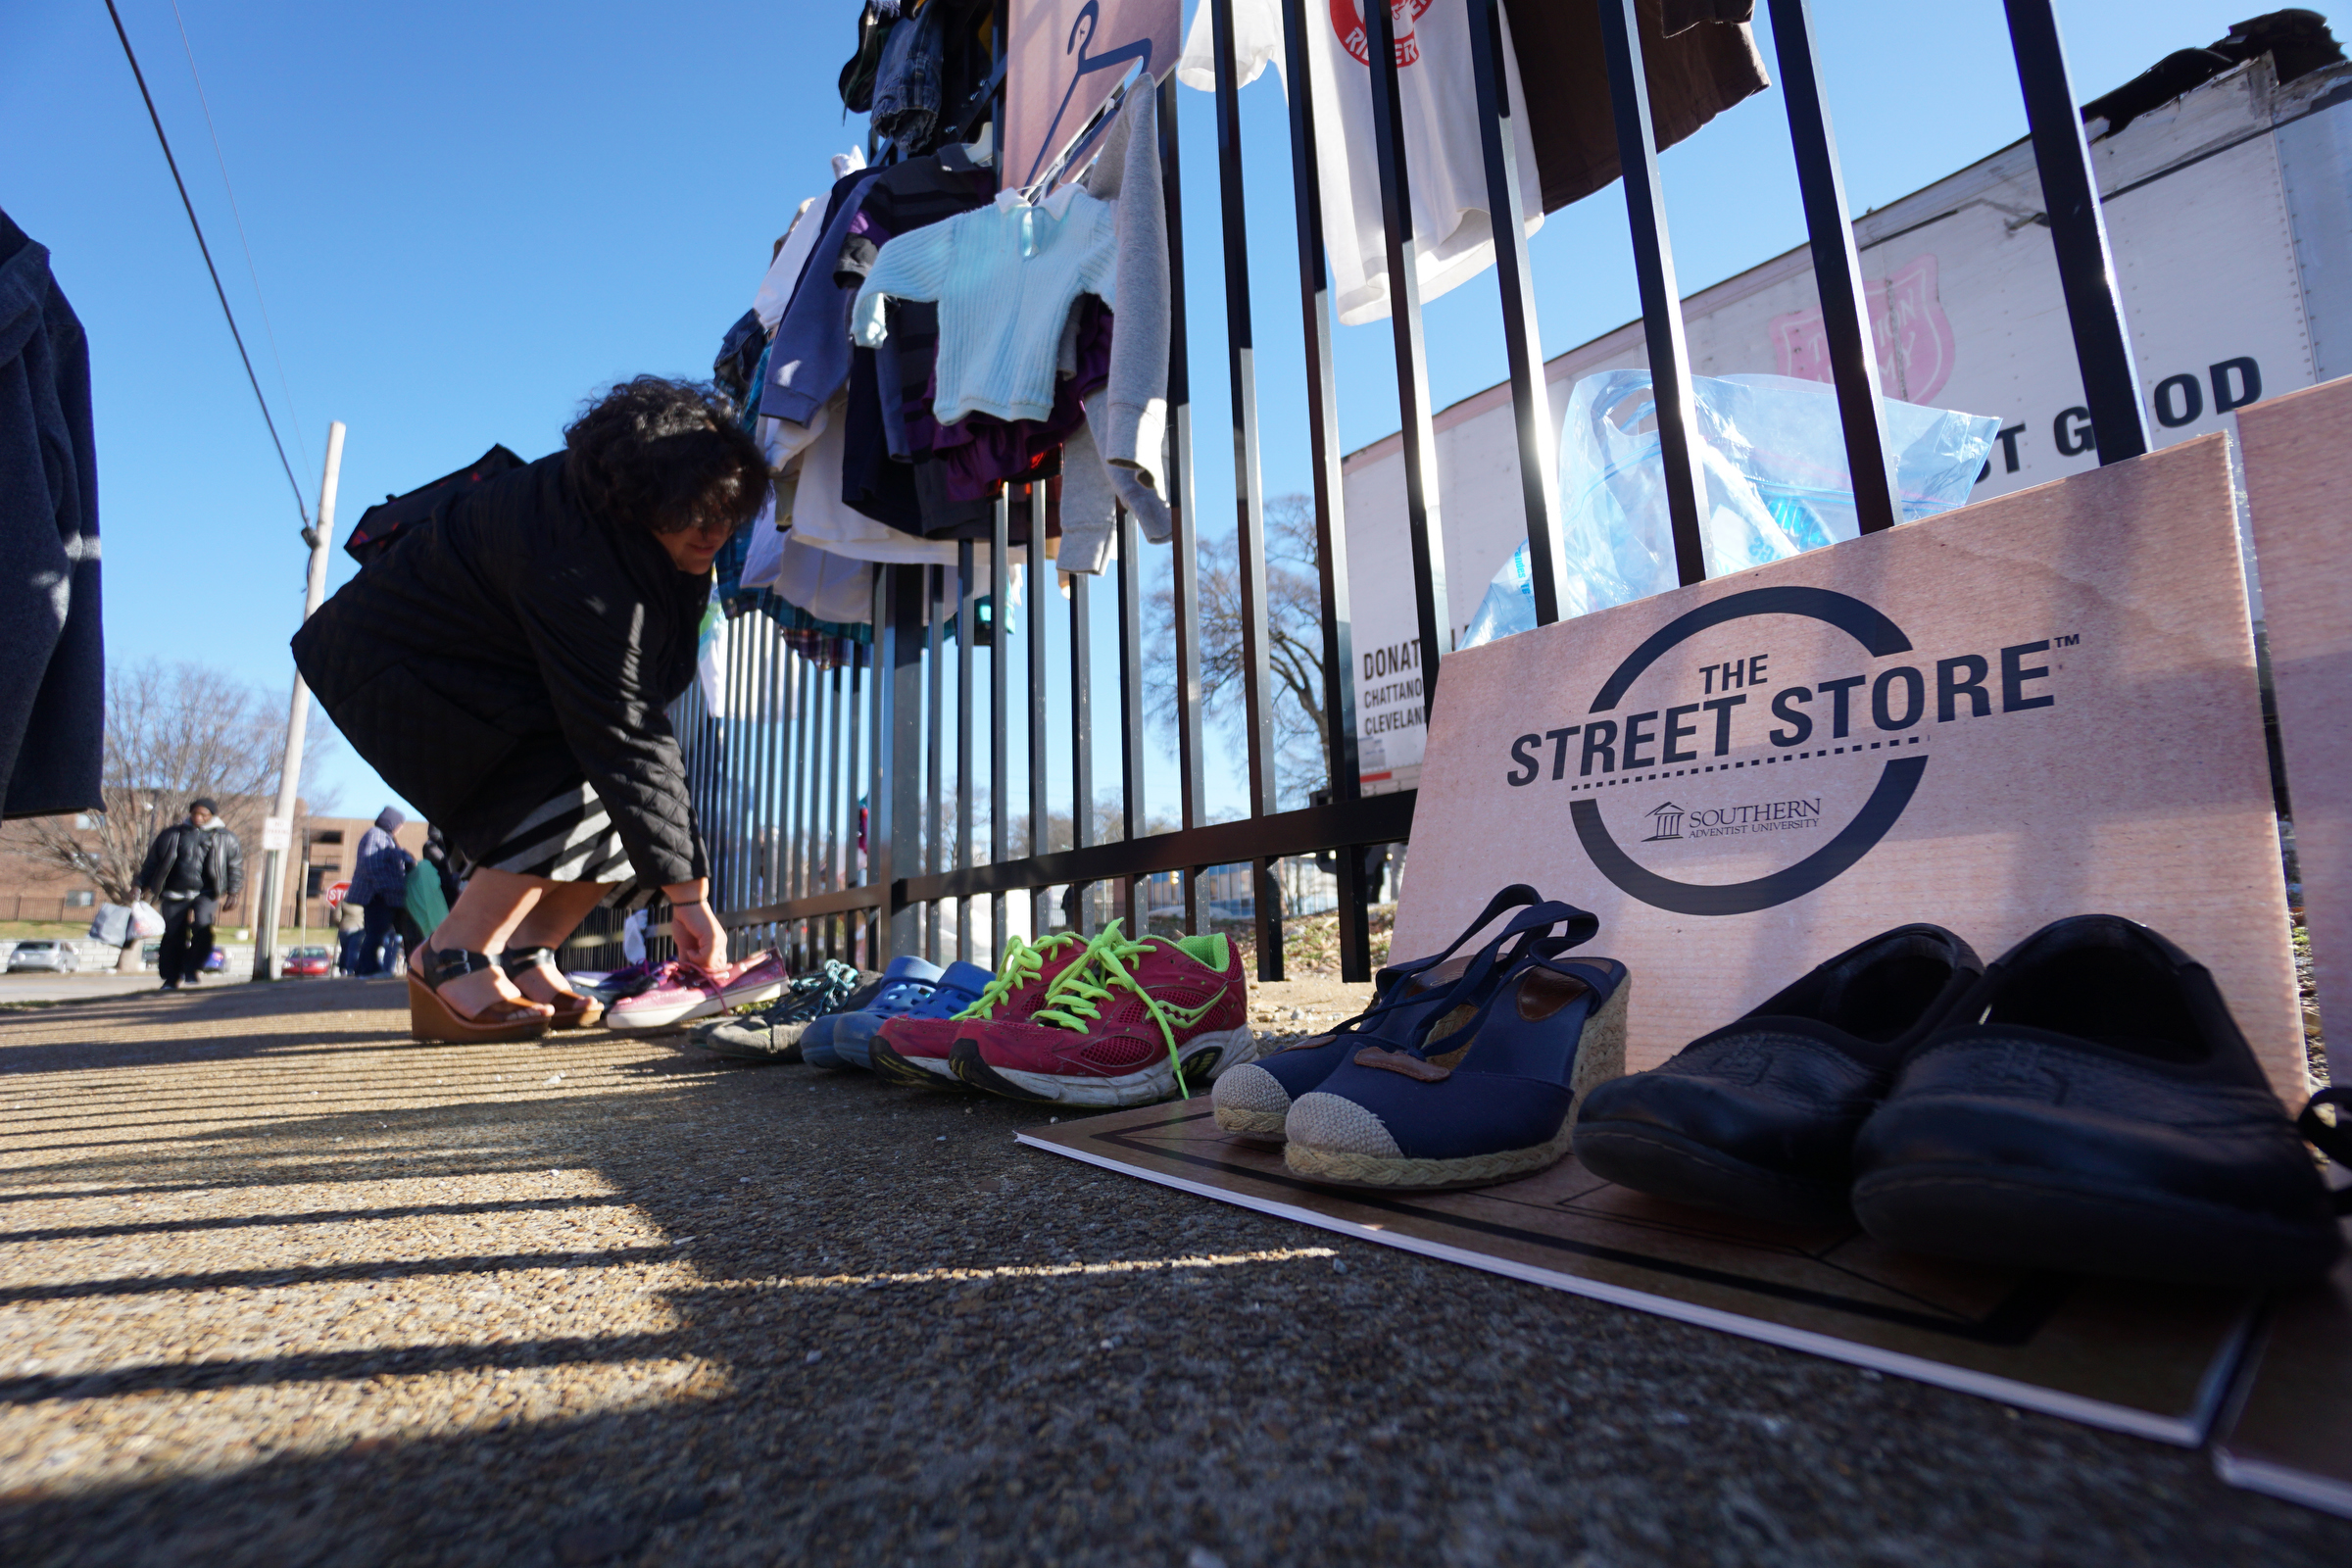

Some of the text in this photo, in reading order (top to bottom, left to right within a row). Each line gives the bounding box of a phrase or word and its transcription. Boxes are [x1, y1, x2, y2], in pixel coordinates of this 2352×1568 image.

[2053, 356, 2263, 458] GOD
[1363, 638, 1420, 681] DONAT
[1699, 654, 1768, 695] THE
[1364, 677, 1423, 710] CHATTANO
[1365, 706, 1427, 736] CLEVELAN
[1507, 694, 1746, 787] STREET
[1769, 639, 2055, 748] STORE
[1689, 798, 1821, 829] SOUTHERN
[1689, 818, 1820, 839] ADVENTIST UNIVERSITY
[328, 889, 346, 901] ST
